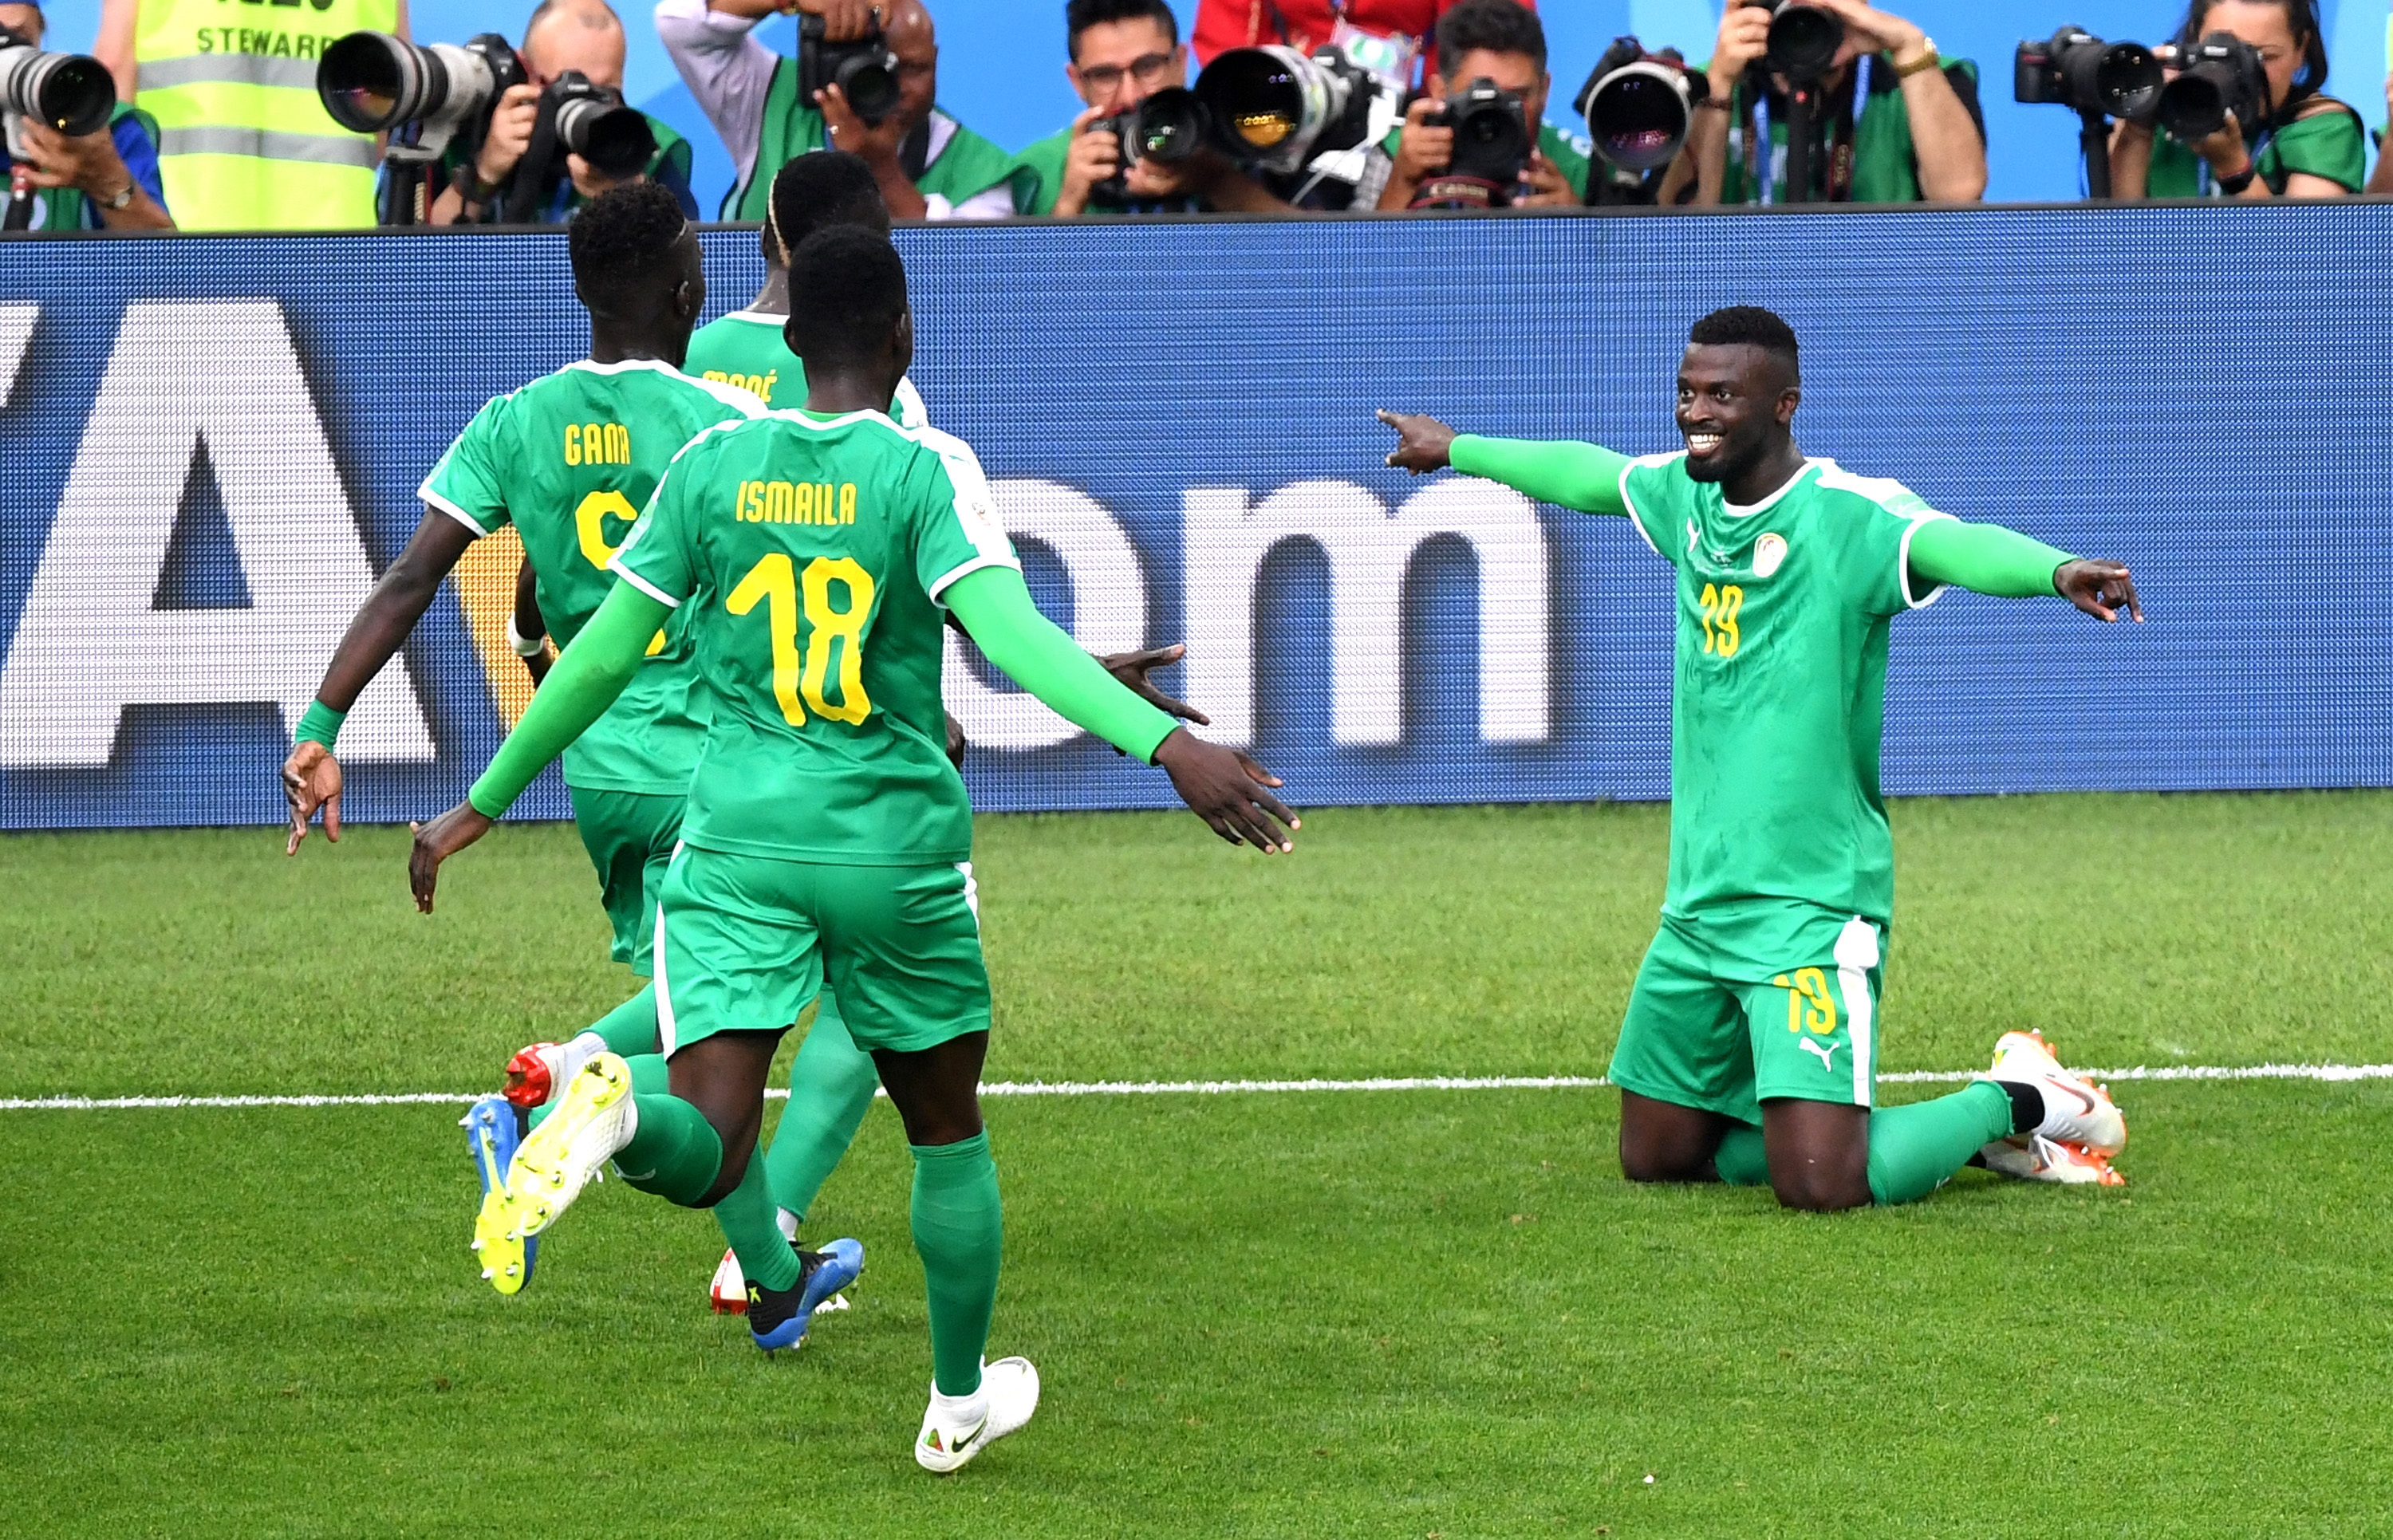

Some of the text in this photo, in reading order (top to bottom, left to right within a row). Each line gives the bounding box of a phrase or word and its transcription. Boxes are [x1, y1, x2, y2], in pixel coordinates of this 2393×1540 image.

[565, 423, 631, 467] GANA
[736, 480, 857, 526] ISMAILA
[725, 552, 875, 727] 18
[1700, 582, 1744, 658] 19
[1772, 967, 1836, 1035] 19
